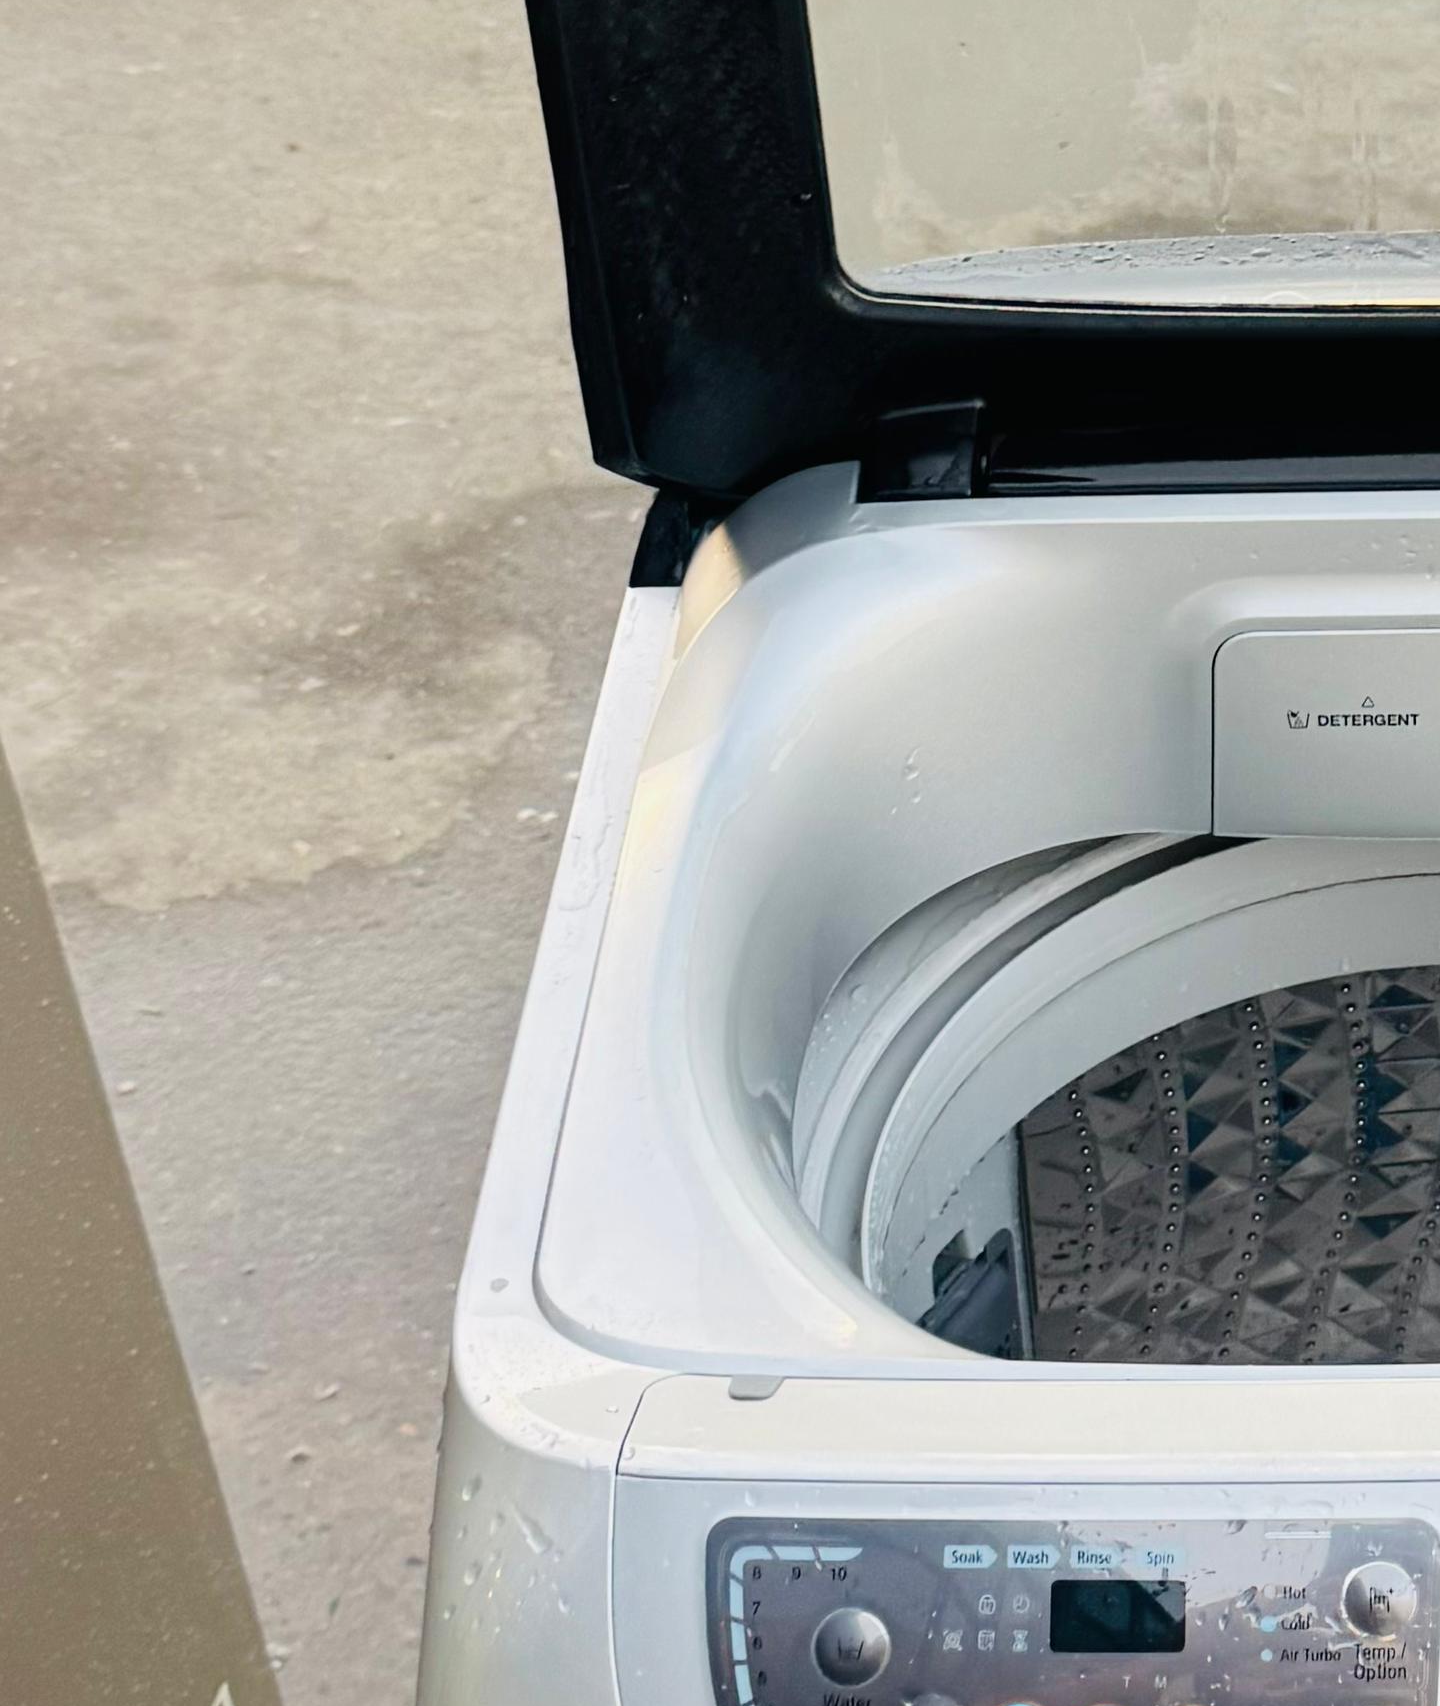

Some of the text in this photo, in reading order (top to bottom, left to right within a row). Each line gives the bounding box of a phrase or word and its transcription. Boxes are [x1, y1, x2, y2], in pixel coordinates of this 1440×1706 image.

[1317, 713, 1420, 727] DETERGENT
[952, 1549, 984, 1564] Soak
[1012, 1549, 1049, 1564] Wash
[1077, 1550, 1113, 1564] Rinse
[1147, 1549, 1175, 1568] Spin
[831, 1566, 848, 1581] 10
[752, 1601, 761, 1616] 7
[1280, 1648, 1342, 1662] Air Turbo
[1354, 1643, 1396, 1662] Temp
[1353, 1662, 1408, 1682] Option
